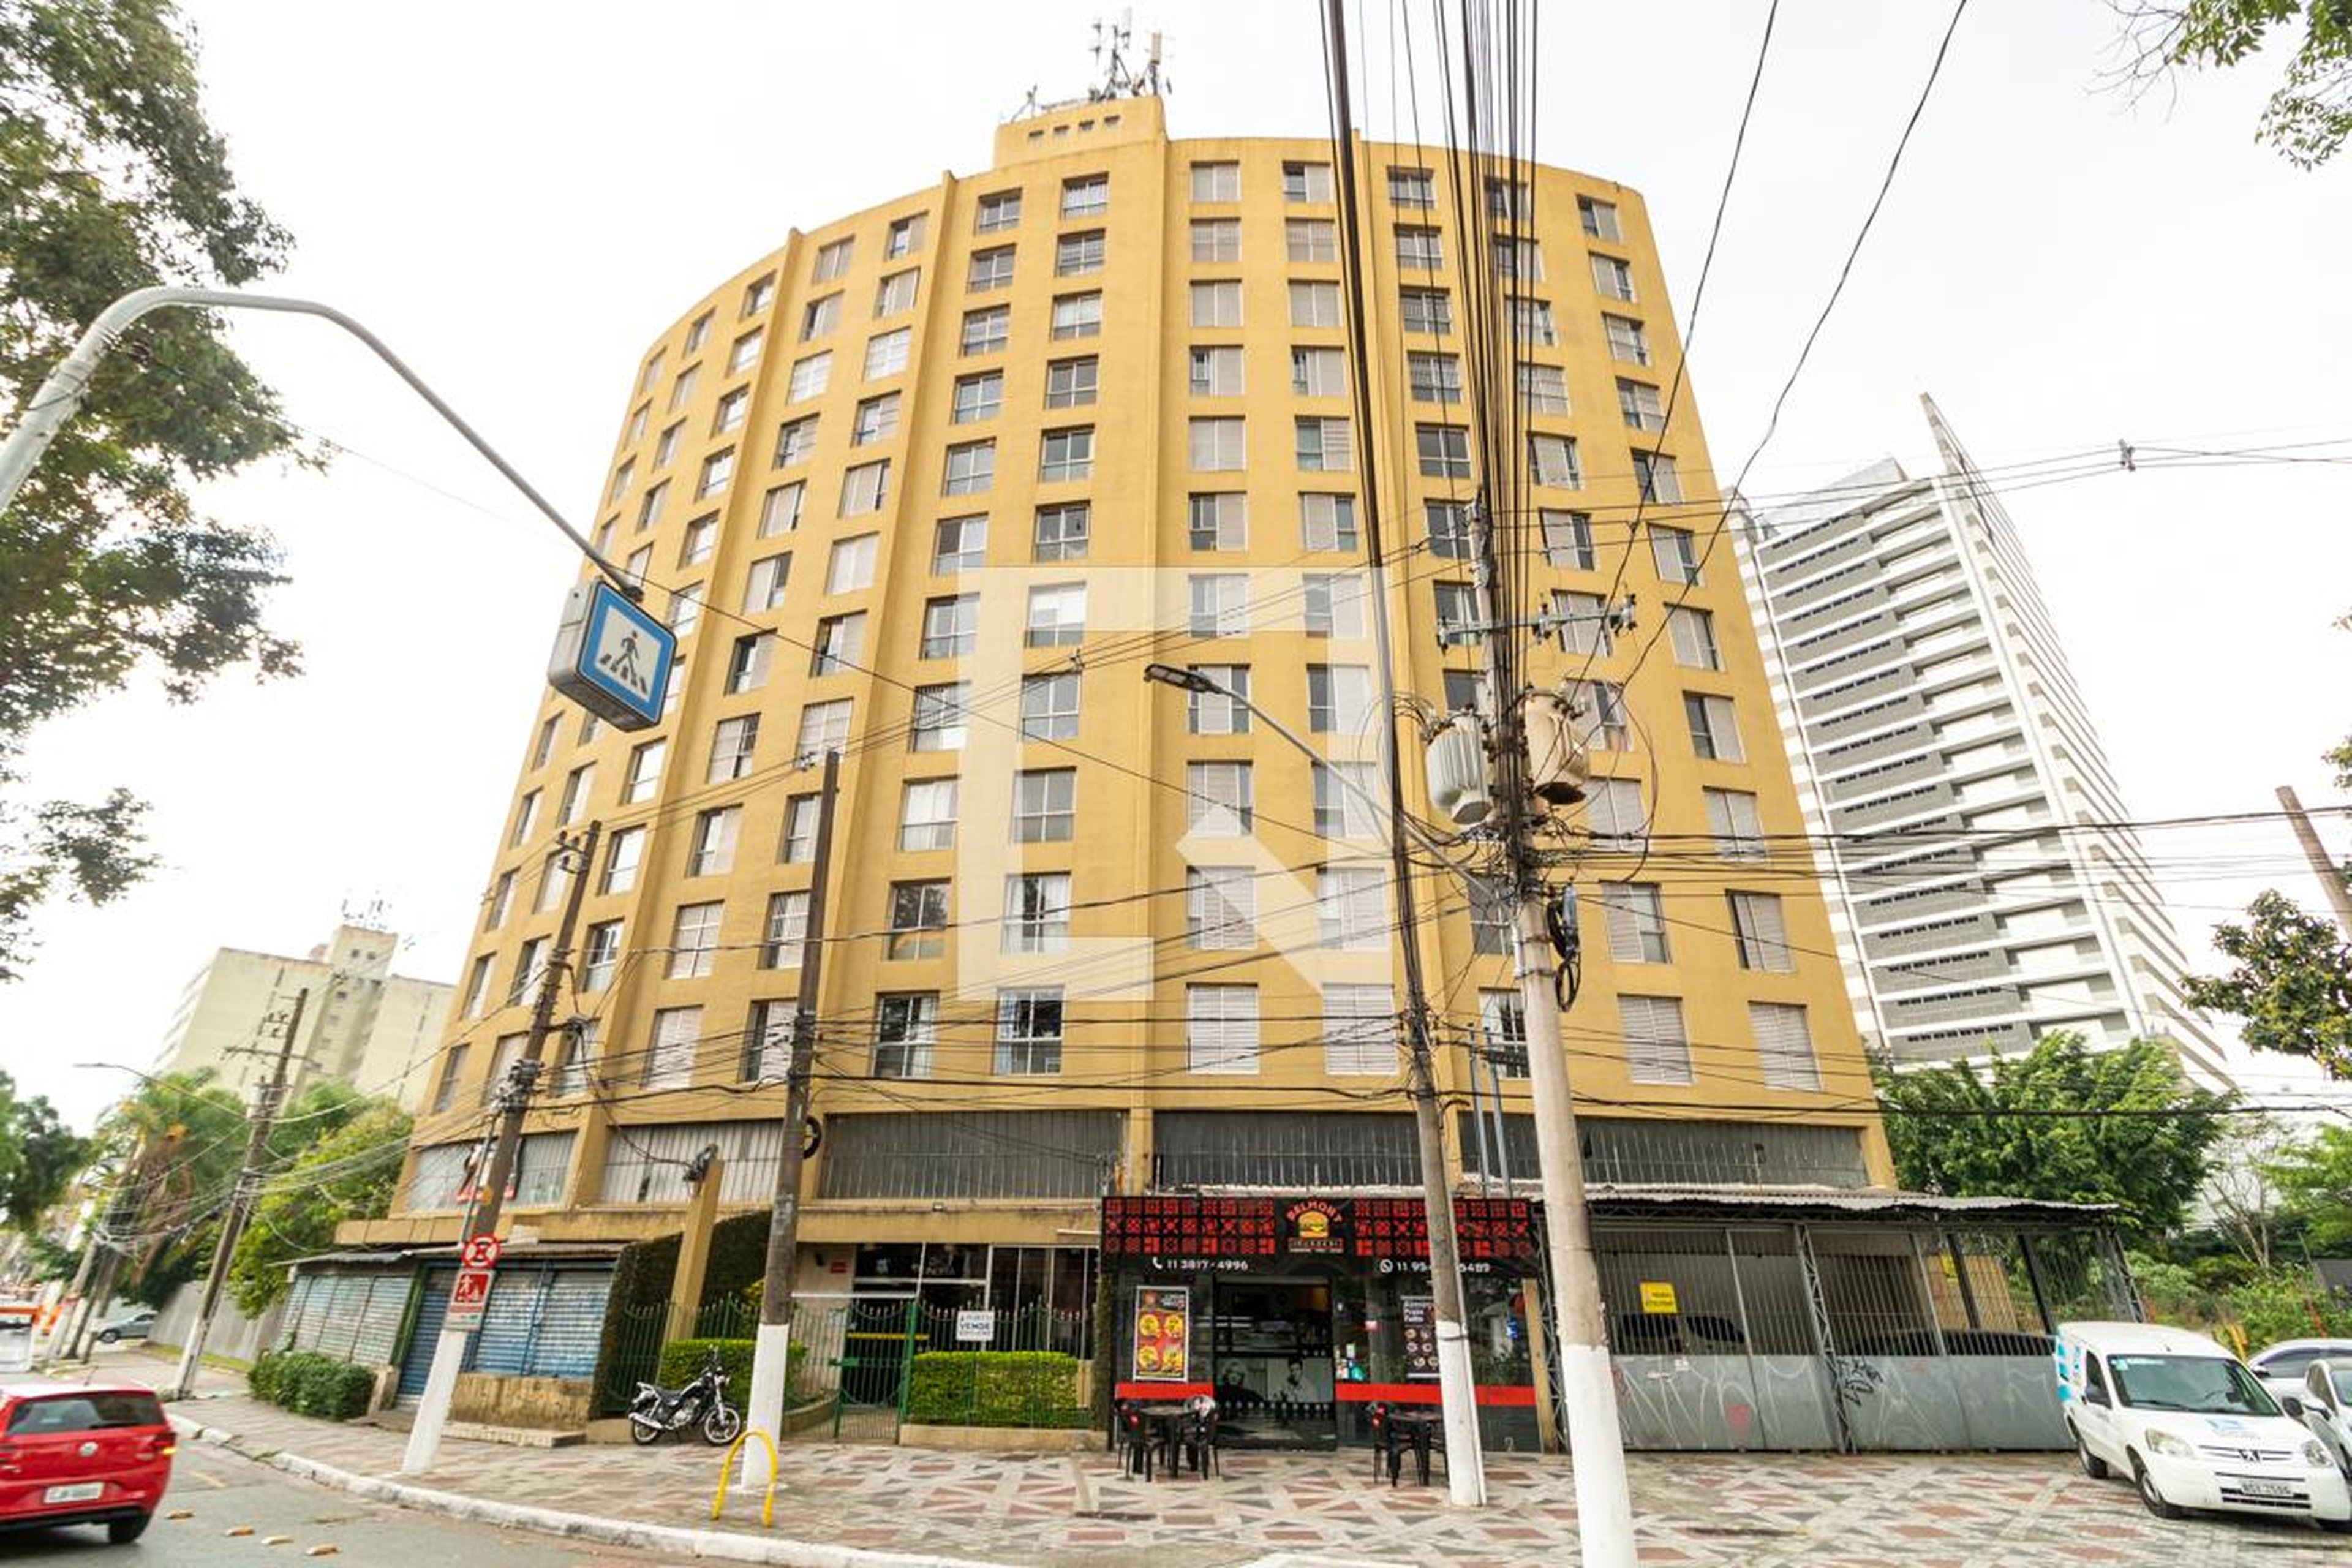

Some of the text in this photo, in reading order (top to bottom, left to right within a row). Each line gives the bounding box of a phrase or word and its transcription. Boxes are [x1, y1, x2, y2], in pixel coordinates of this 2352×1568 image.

[1287, 1200, 1343, 1222] BELMONT
[1167, 1259, 1177, 1269] 11
[1396, 1262, 1408, 1272] 11
